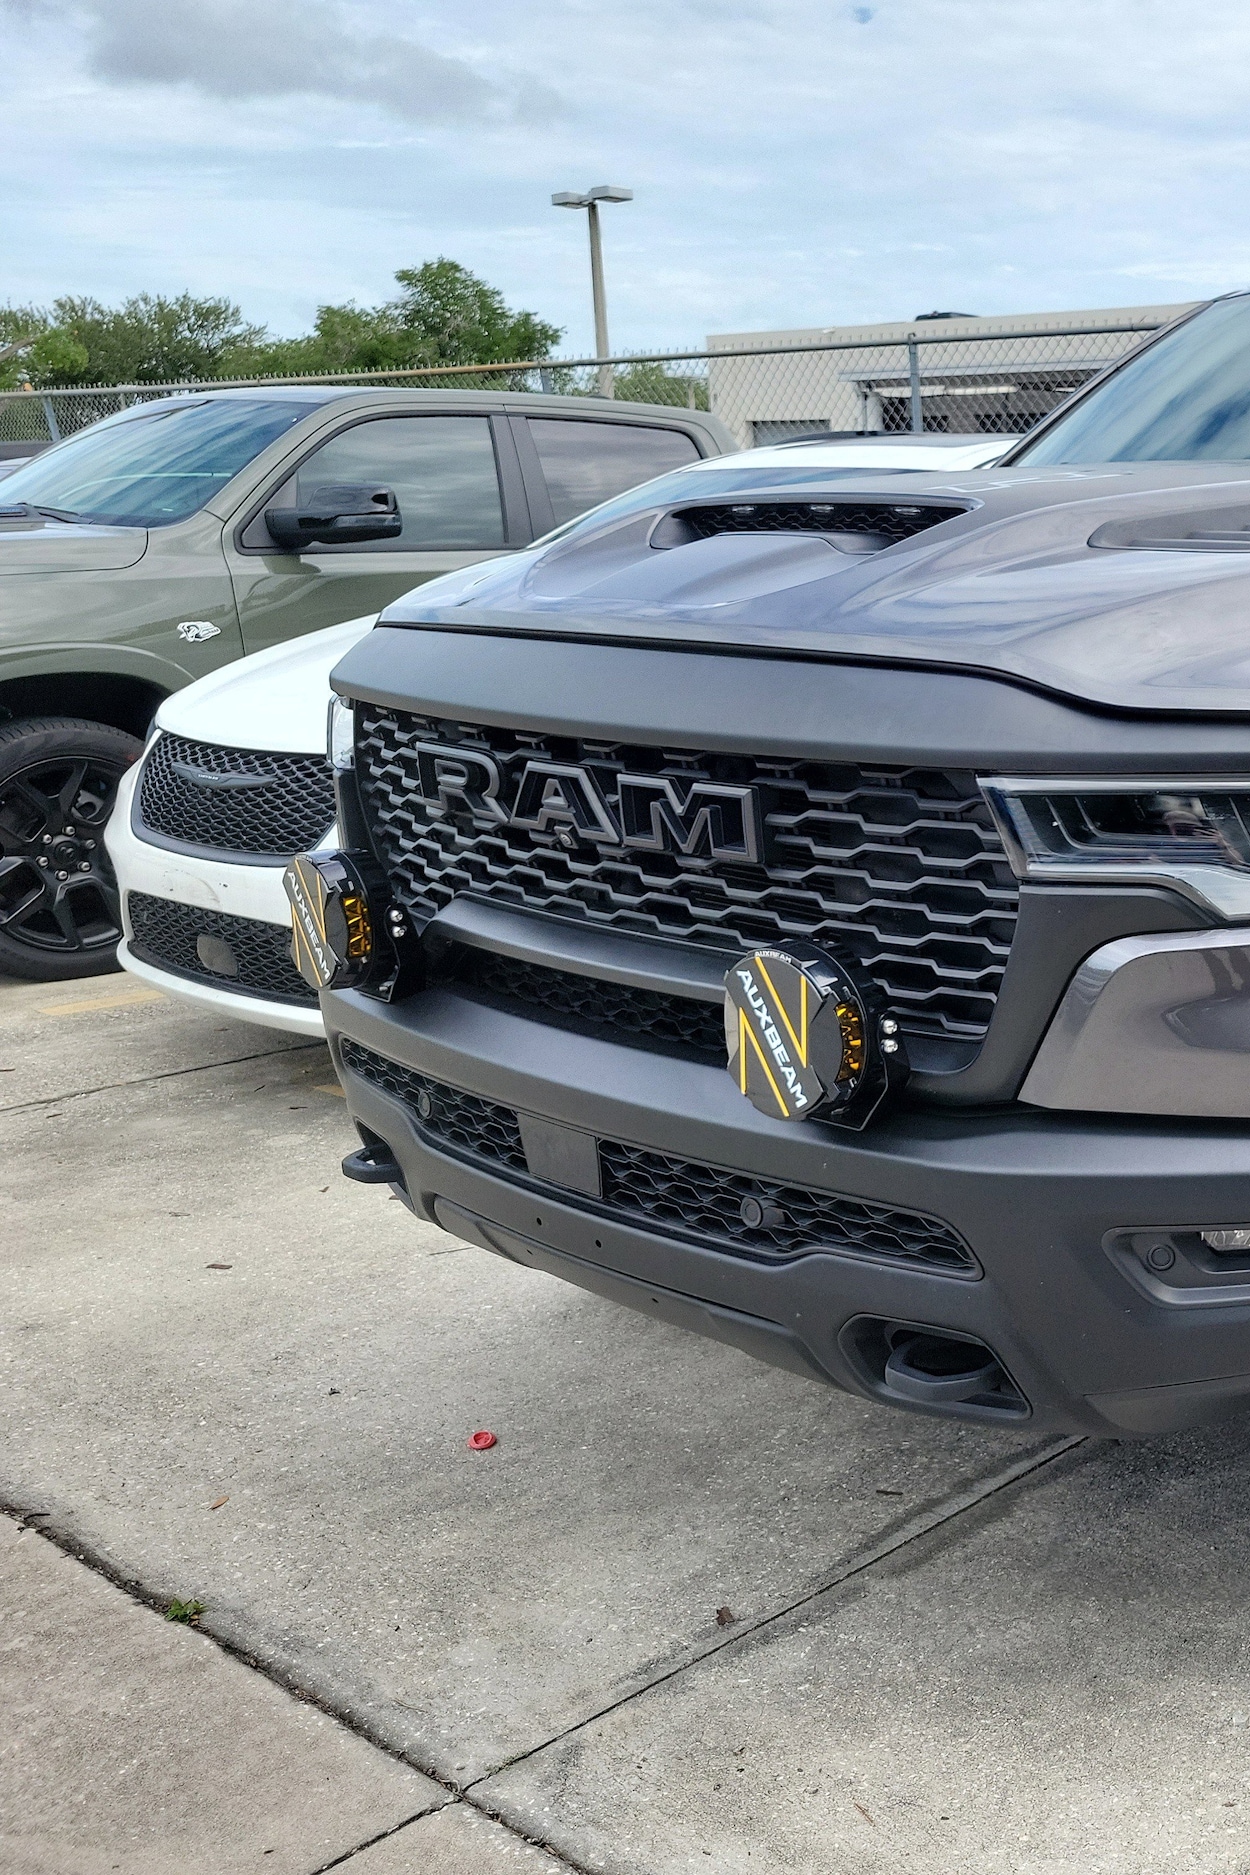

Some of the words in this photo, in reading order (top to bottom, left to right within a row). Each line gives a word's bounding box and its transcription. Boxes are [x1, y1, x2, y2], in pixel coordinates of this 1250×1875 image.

[415, 741, 765, 863] RAM
[288, 872, 331, 980] AUXBEAM
[754, 950, 792, 964] AUXBEAM
[736, 969, 808, 1109] AUXBEAM
